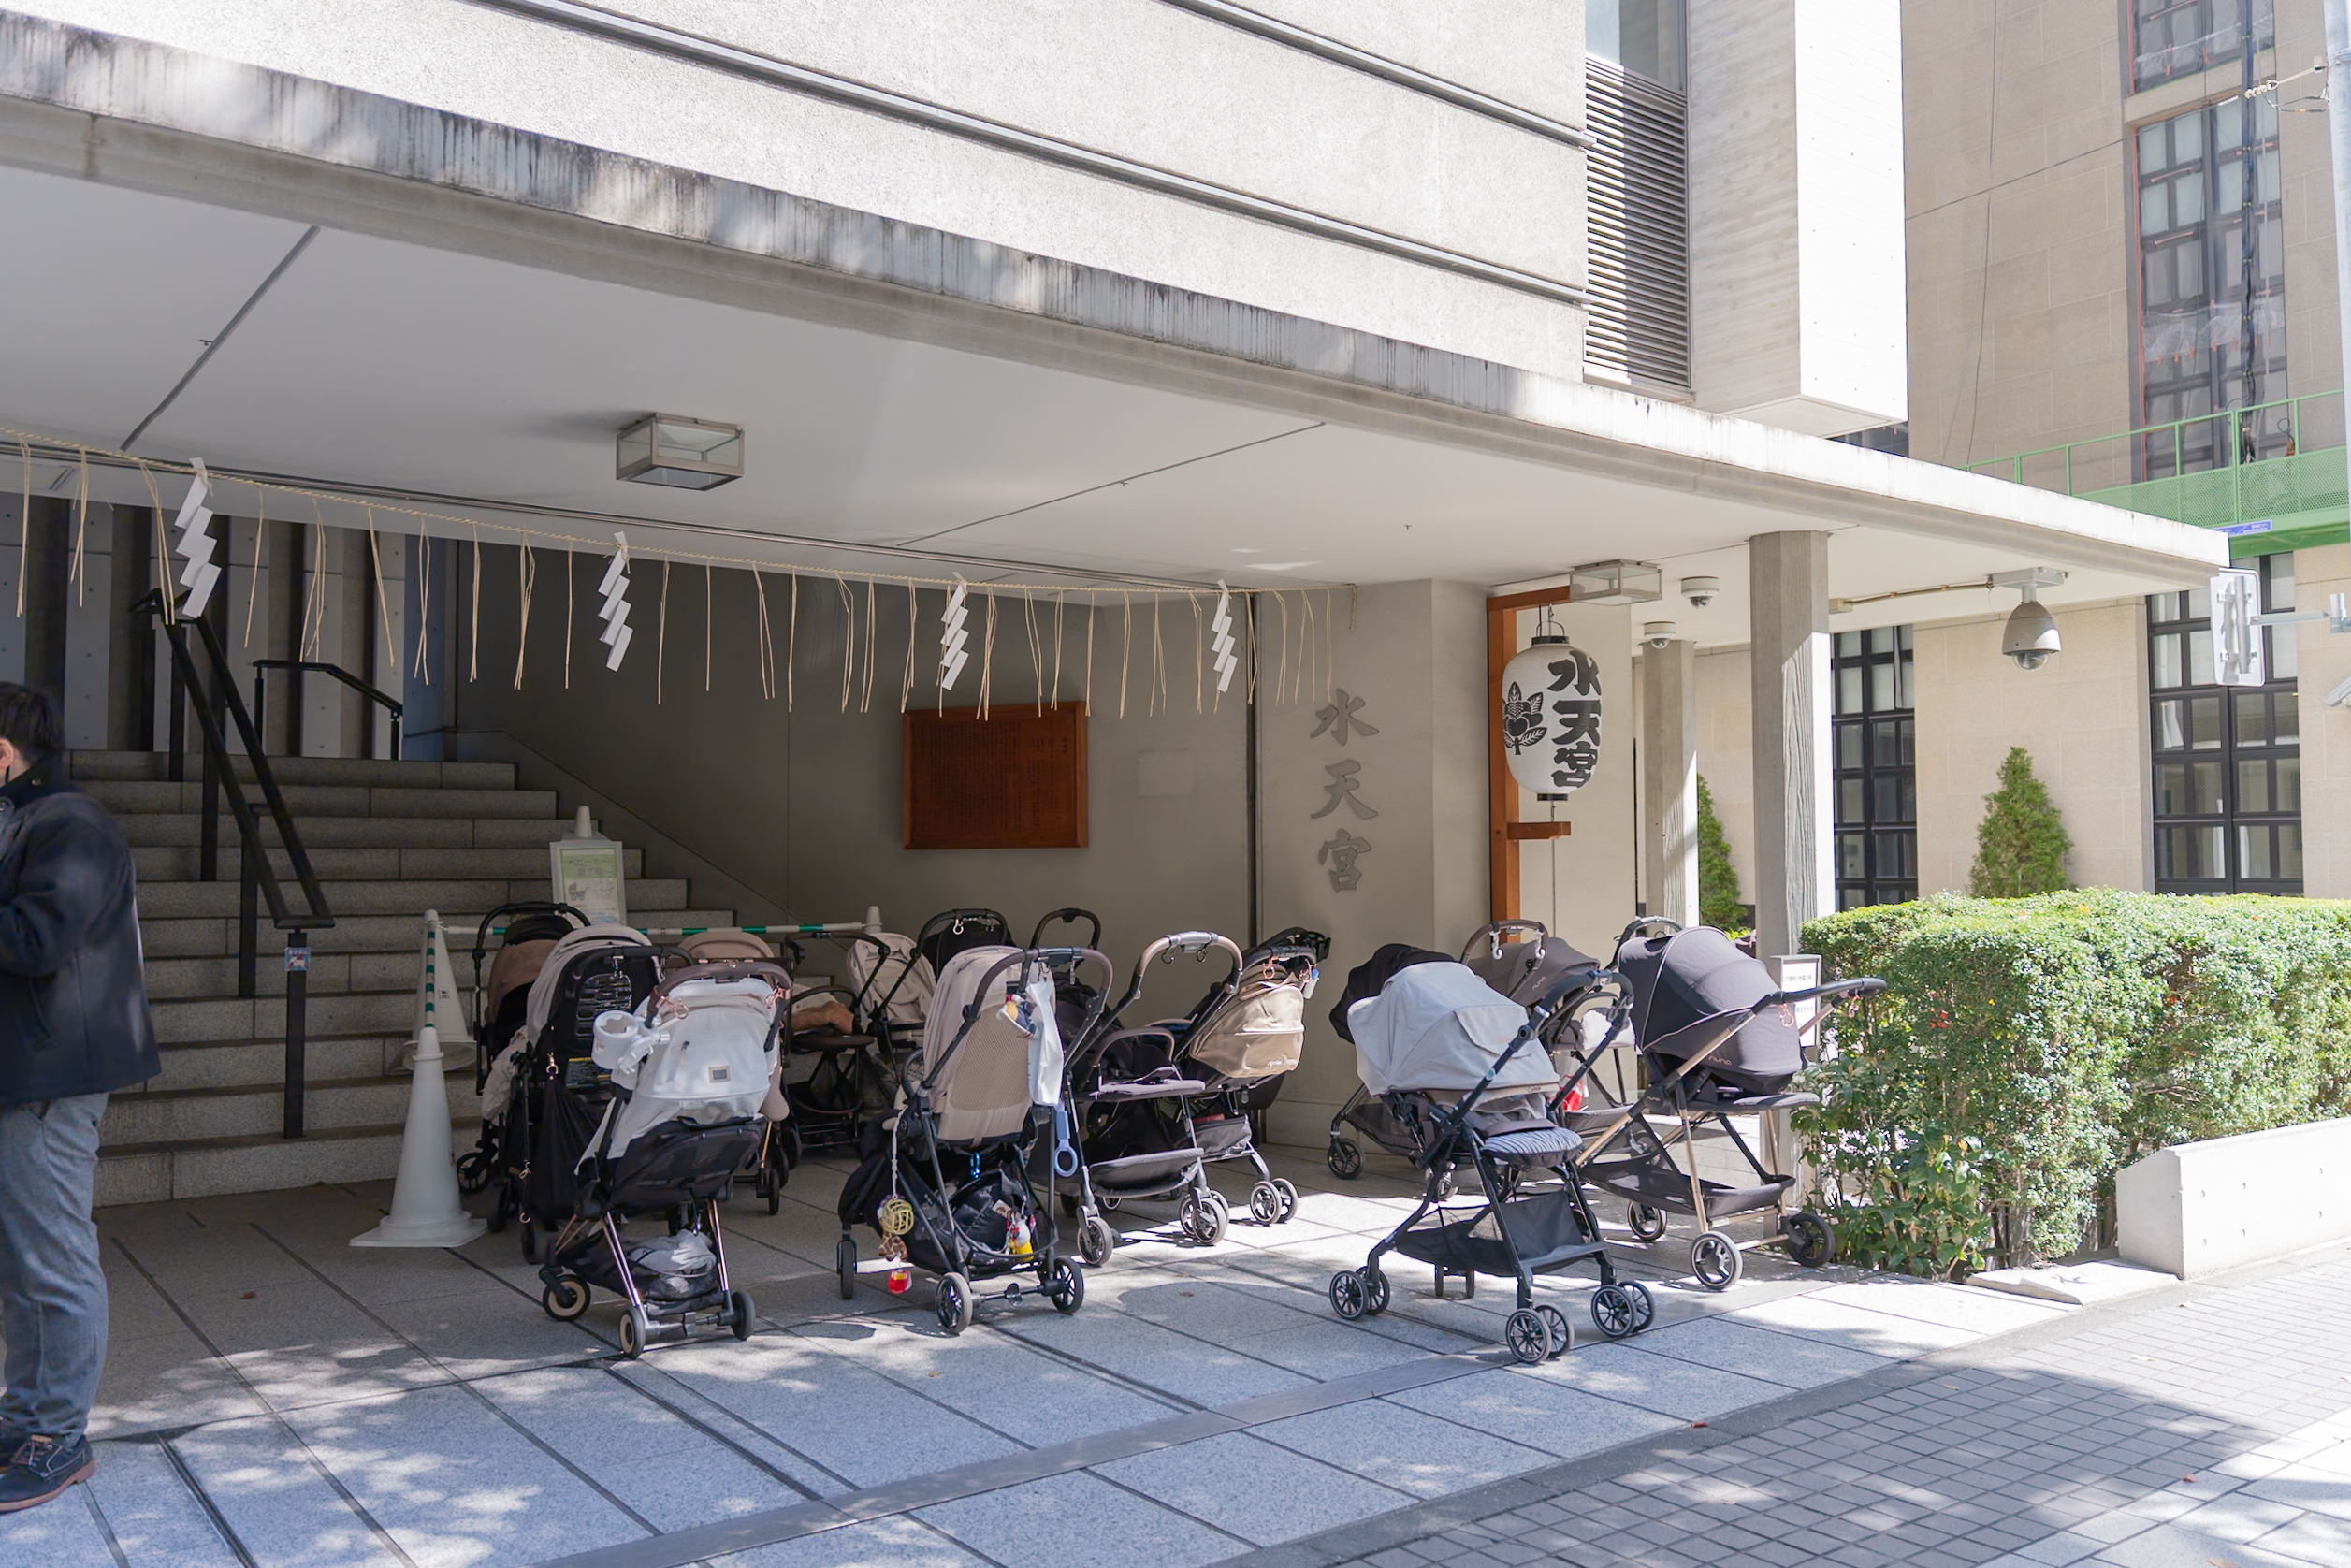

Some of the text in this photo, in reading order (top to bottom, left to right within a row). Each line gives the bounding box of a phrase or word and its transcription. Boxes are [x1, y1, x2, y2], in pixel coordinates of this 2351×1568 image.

[1547, 650, 1602, 789] 水天宮
[1311, 688, 1380, 893] 水天宮
[1708, 1055, 1733, 1066] nuna
